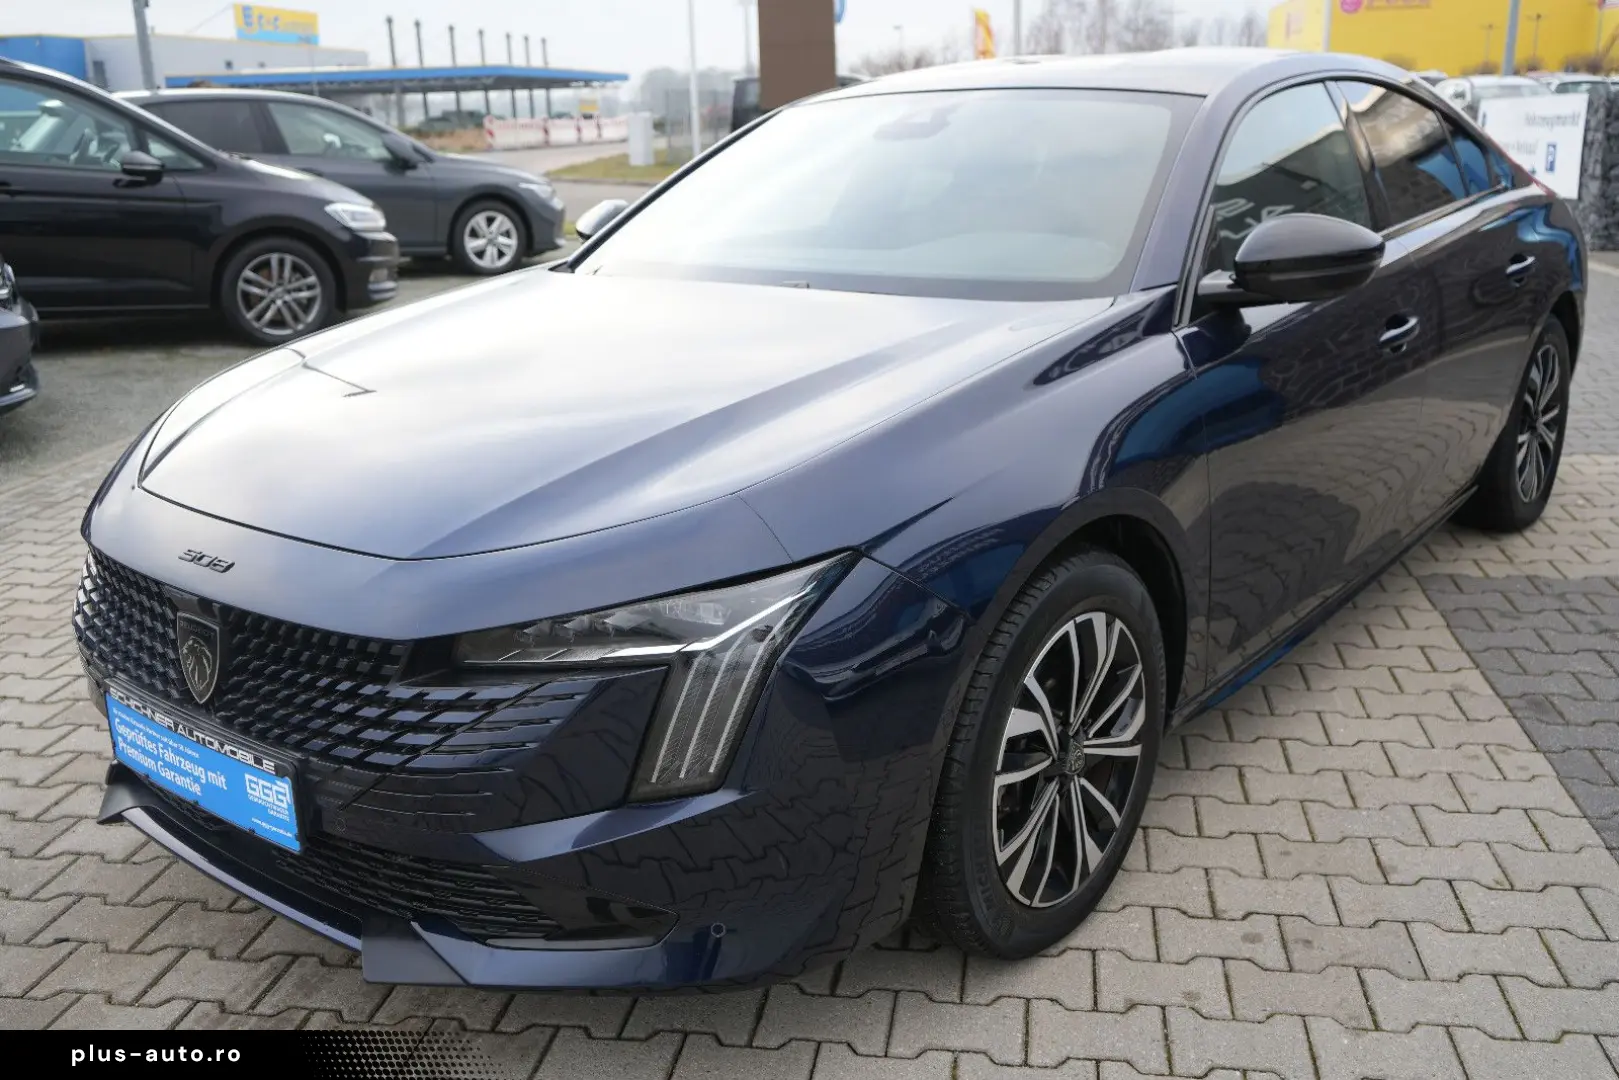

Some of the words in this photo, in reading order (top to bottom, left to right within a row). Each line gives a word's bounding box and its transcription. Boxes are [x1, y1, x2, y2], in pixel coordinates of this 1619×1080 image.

[178, 549, 236, 573] 508
[115, 718, 158, 755] Geprüftes
[158, 743, 206, 784] Fahrzeug
[208, 771, 228, 791] mit
[117, 735, 155, 770] Premium
[157, 761, 203, 797] Garantie
[177, 724, 275, 775] AUTOMOBILE
[245, 773, 290, 809] GGG
